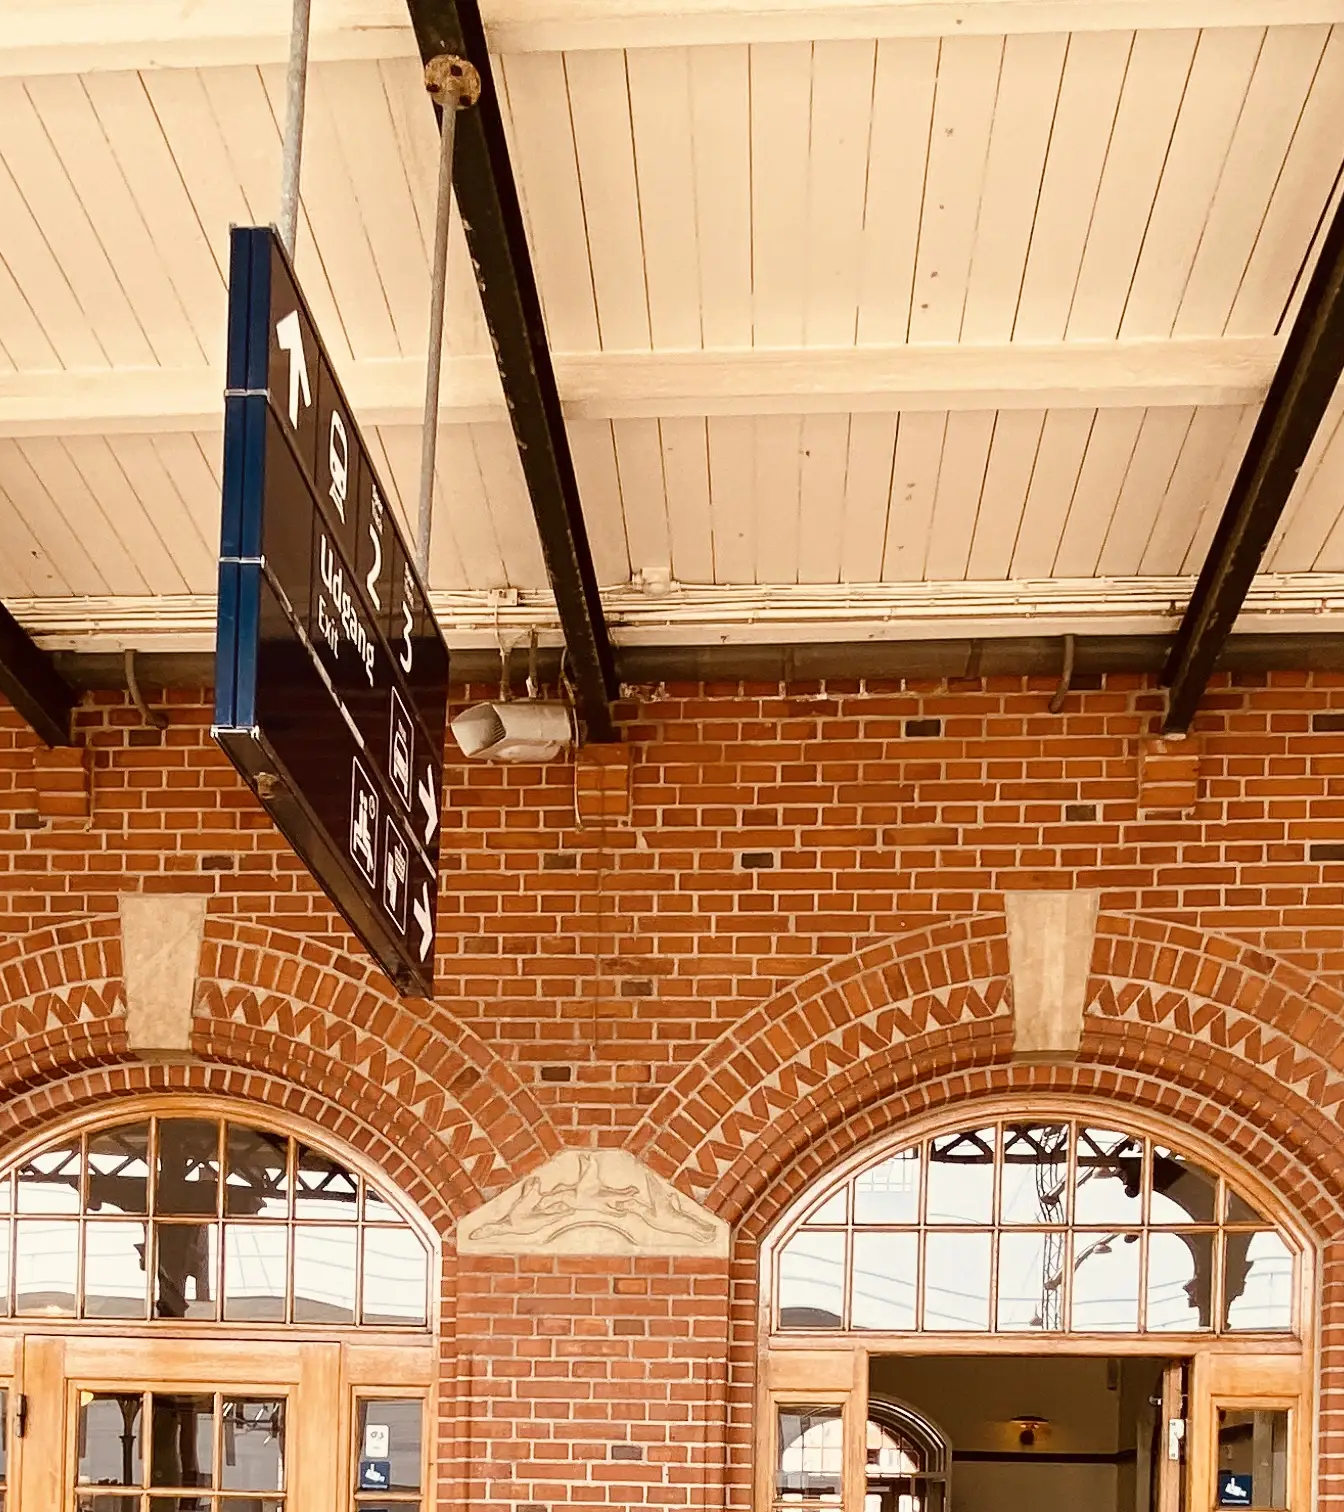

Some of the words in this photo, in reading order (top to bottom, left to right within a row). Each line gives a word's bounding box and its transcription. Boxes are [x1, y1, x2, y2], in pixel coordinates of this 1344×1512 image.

[318, 594, 338, 659] Exit
[320, 534, 374, 687] Udgang
[367, 523, 381, 611] 2
[400, 600, 413, 673] 3
